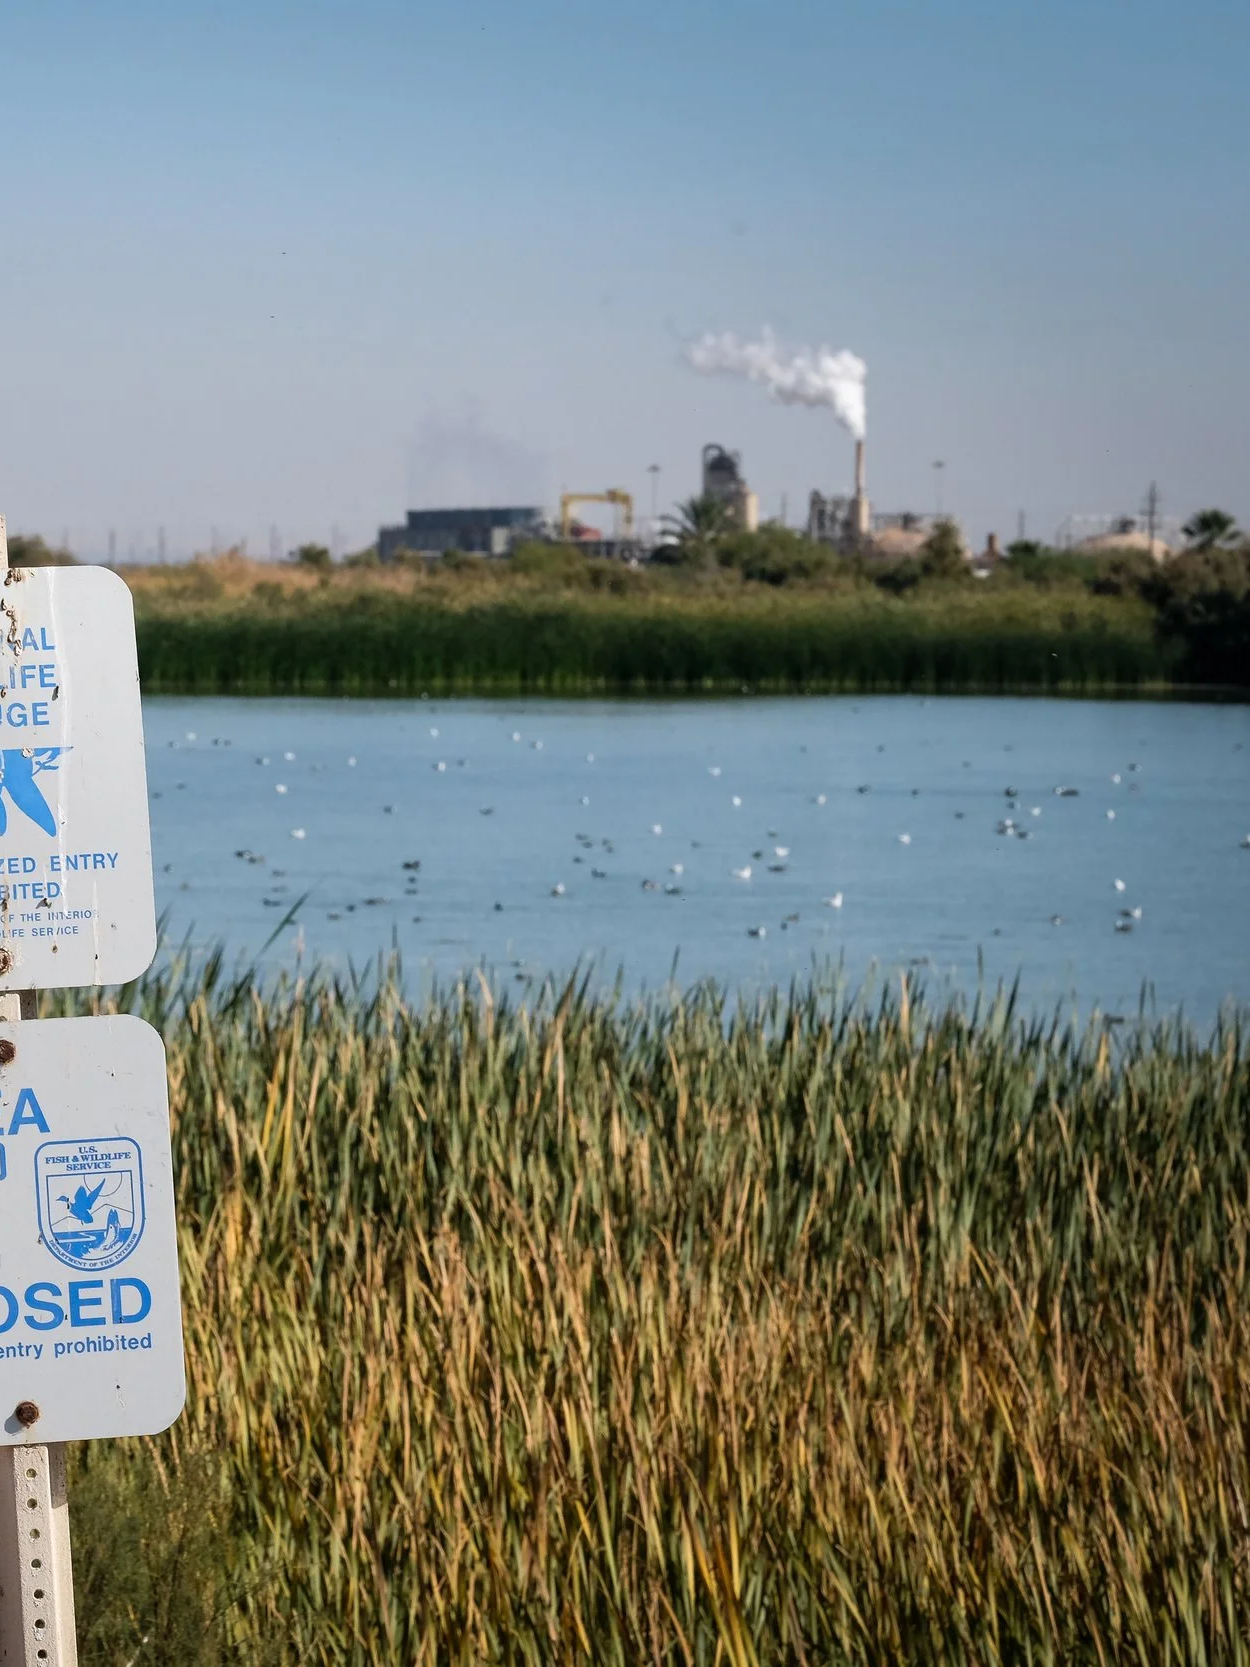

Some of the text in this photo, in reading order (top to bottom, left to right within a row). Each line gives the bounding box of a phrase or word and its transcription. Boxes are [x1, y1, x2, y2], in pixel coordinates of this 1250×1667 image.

[50, 852, 118, 871] ENTRY
[20, 912, 41, 922] THE
[48, 909, 99, 921] INTERIO
[78, 1145, 98, 1154] U.S.
[45, 1155, 69, 1164] FISH
[80, 1151, 132, 1162] WILDLIFE
[66, 1161, 111, 1171] SERVICE
[54, 1332, 152, 1358] prohibited
